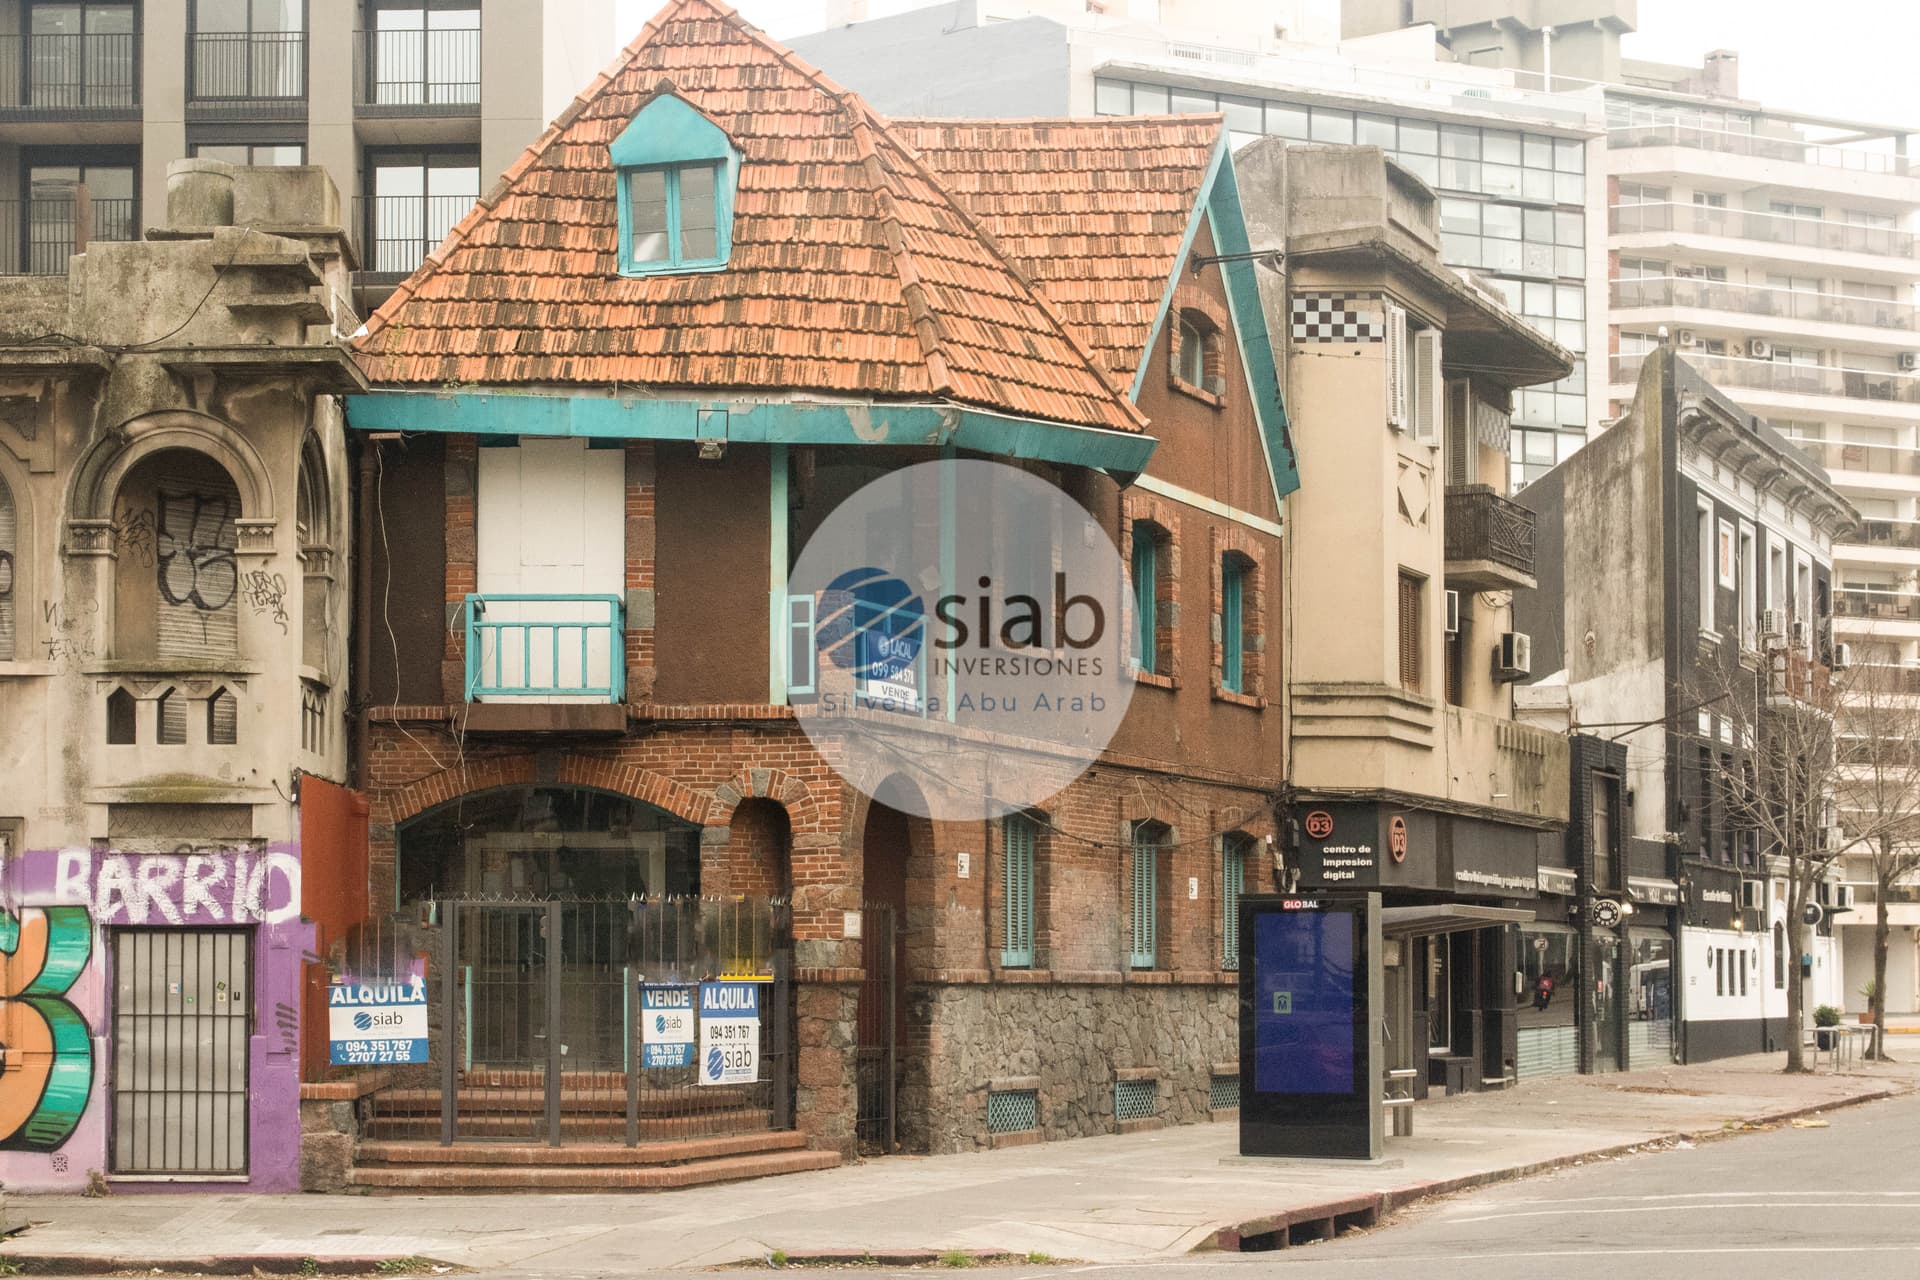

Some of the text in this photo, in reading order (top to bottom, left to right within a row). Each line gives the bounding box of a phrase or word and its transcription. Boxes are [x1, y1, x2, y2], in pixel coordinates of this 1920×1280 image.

[881, 685, 910, 699] VENDE
[1322, 844, 1371, 854] centro de
[1322, 870, 1355, 881] digital
[54, 848, 302, 926] BARRIO
[331, 982, 425, 1005] ALQUILA
[646, 990, 690, 1007] VENDE
[703, 987, 755, 1010] ALQUILA
[373, 1011, 403, 1026] siab
[666, 1016, 682, 1029] siab
[710, 1025, 750, 1040] 094 351 767
[345, 1040, 413, 1052] 094 351 767
[348, 1051, 411, 1063] 2707 27 55
[724, 1044, 752, 1069] siab
